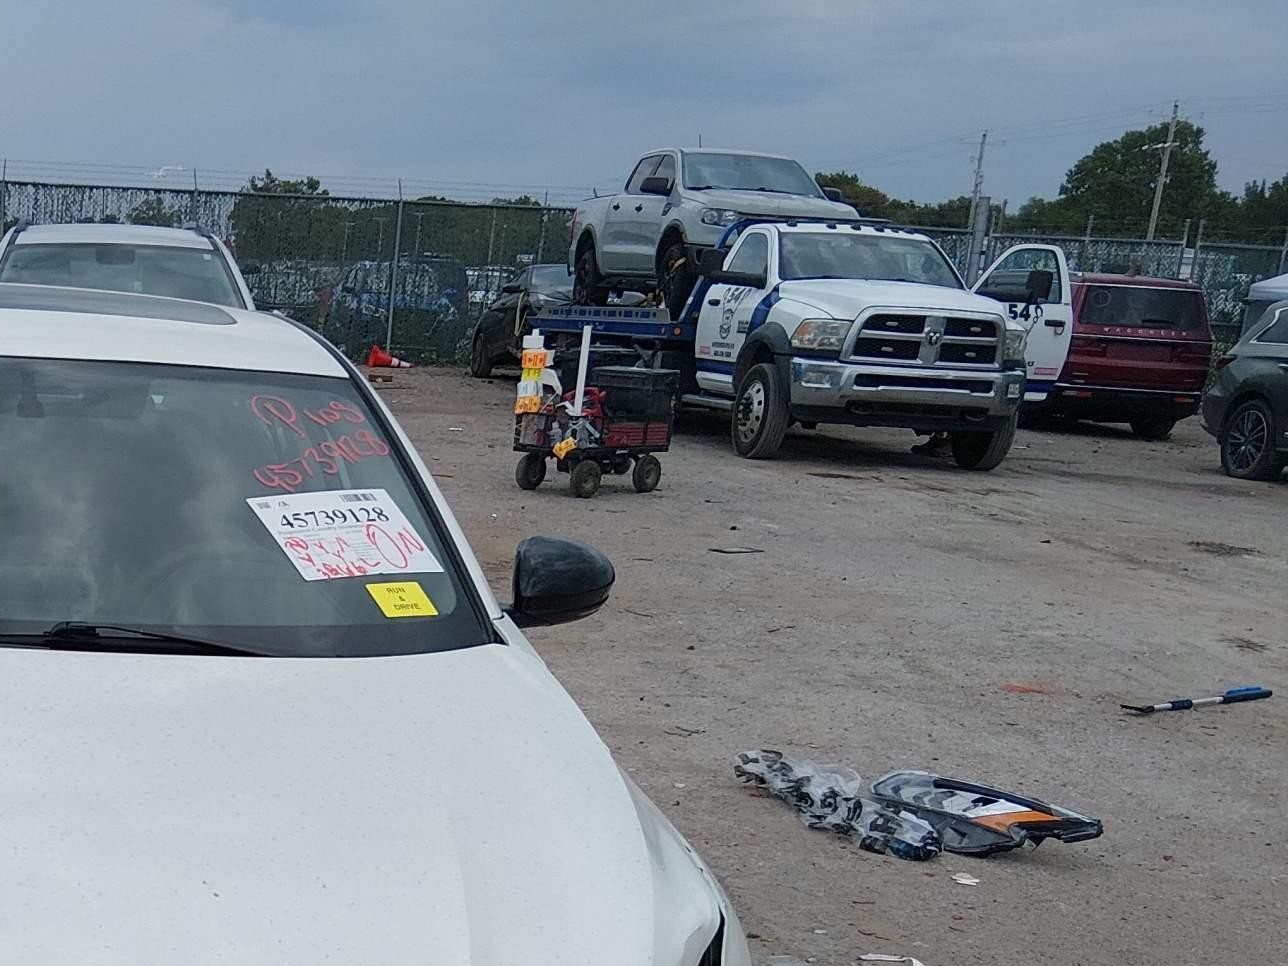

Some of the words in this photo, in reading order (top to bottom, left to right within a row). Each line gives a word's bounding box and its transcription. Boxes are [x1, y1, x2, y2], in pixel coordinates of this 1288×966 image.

[280, 507, 390, 529] 45739128
[386, 586, 406, 594] RUN
[393, 603, 421, 611] DRIVE
